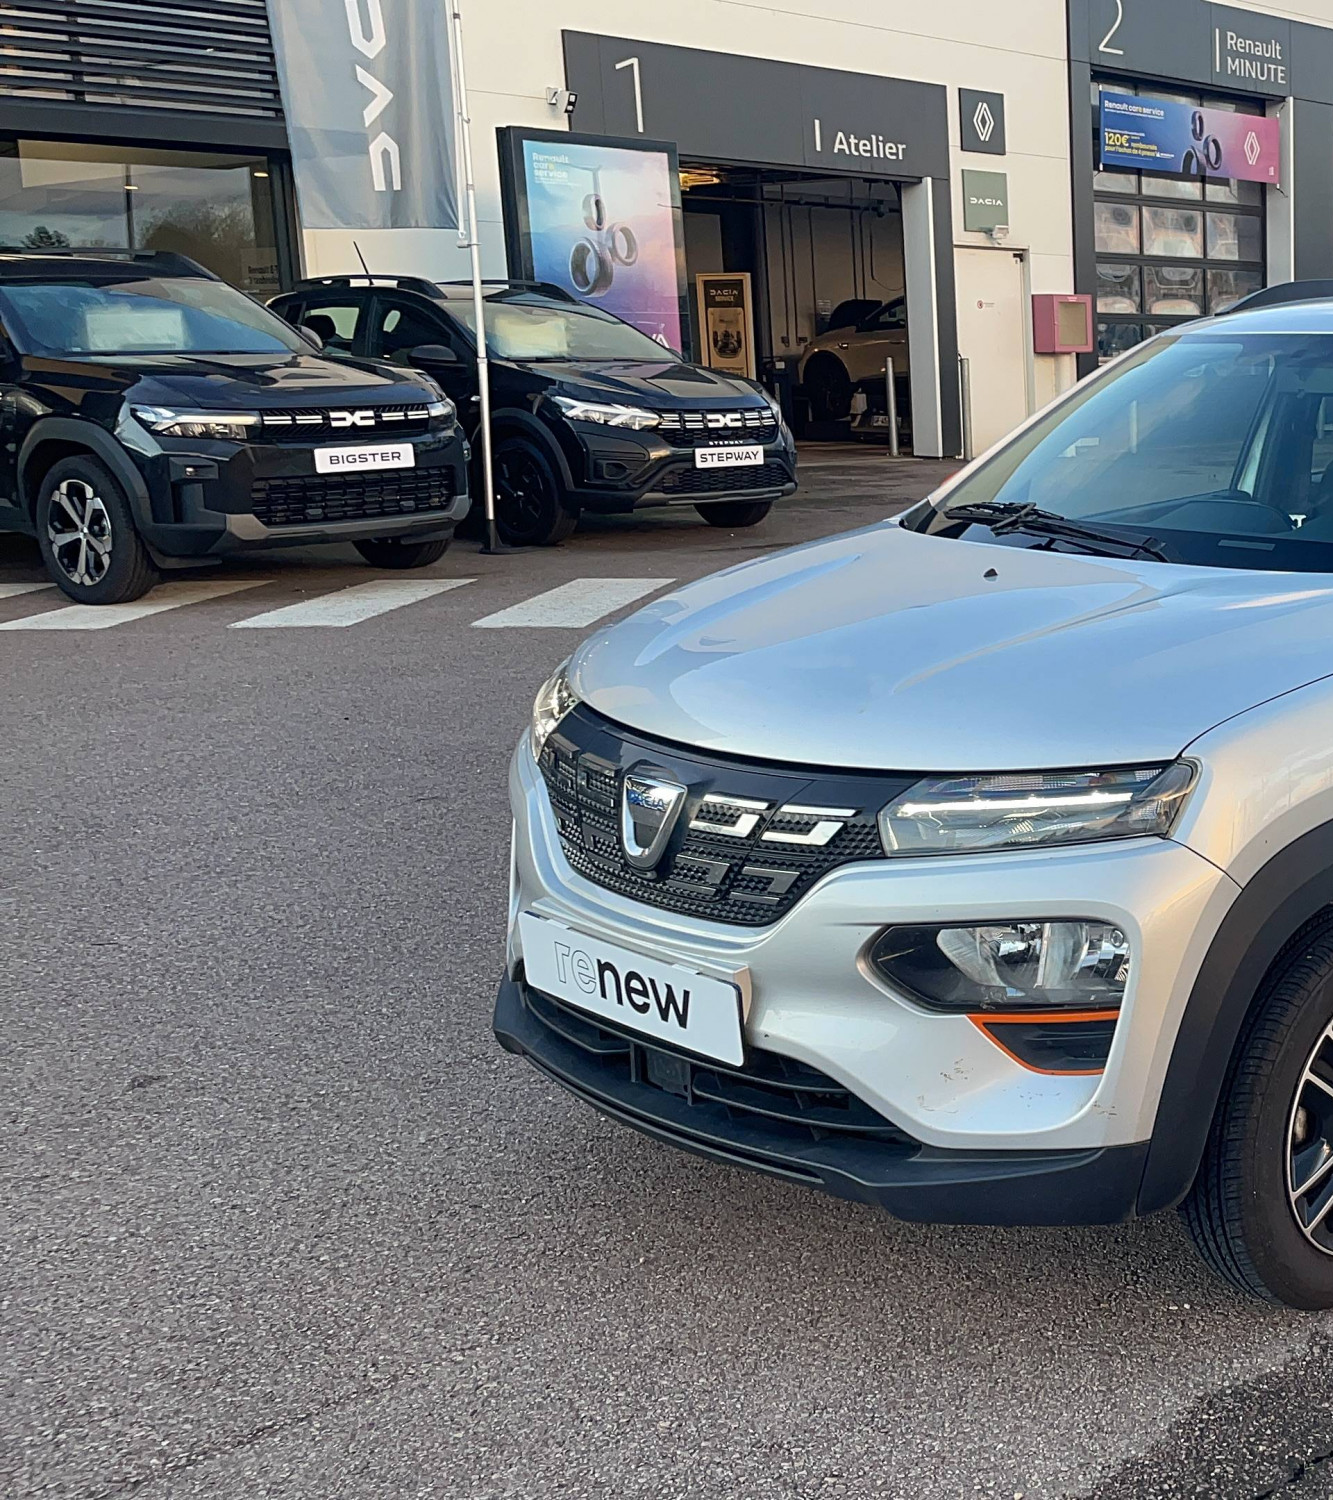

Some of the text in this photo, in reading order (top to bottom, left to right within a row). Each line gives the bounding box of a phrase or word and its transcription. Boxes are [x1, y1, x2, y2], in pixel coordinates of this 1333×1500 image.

[1098, 0, 1124, 56] 2
[1226, 31, 1282, 60] Renault
[1227, 56, 1287, 84] MINUTE
[615, 57, 644, 133] 1
[1104, 99, 1128, 111] Renault
[1142, 107, 1165, 117] service
[833, 131, 907, 160] Atelier
[532, 152, 570, 164] Renault
[533, 169, 569, 179] service
[969, 197, 1004, 206] DACIA
[329, 451, 401, 465] BIGSTER
[700, 450, 759, 463] STEPWAY
[554, 941, 690, 1029] renew
